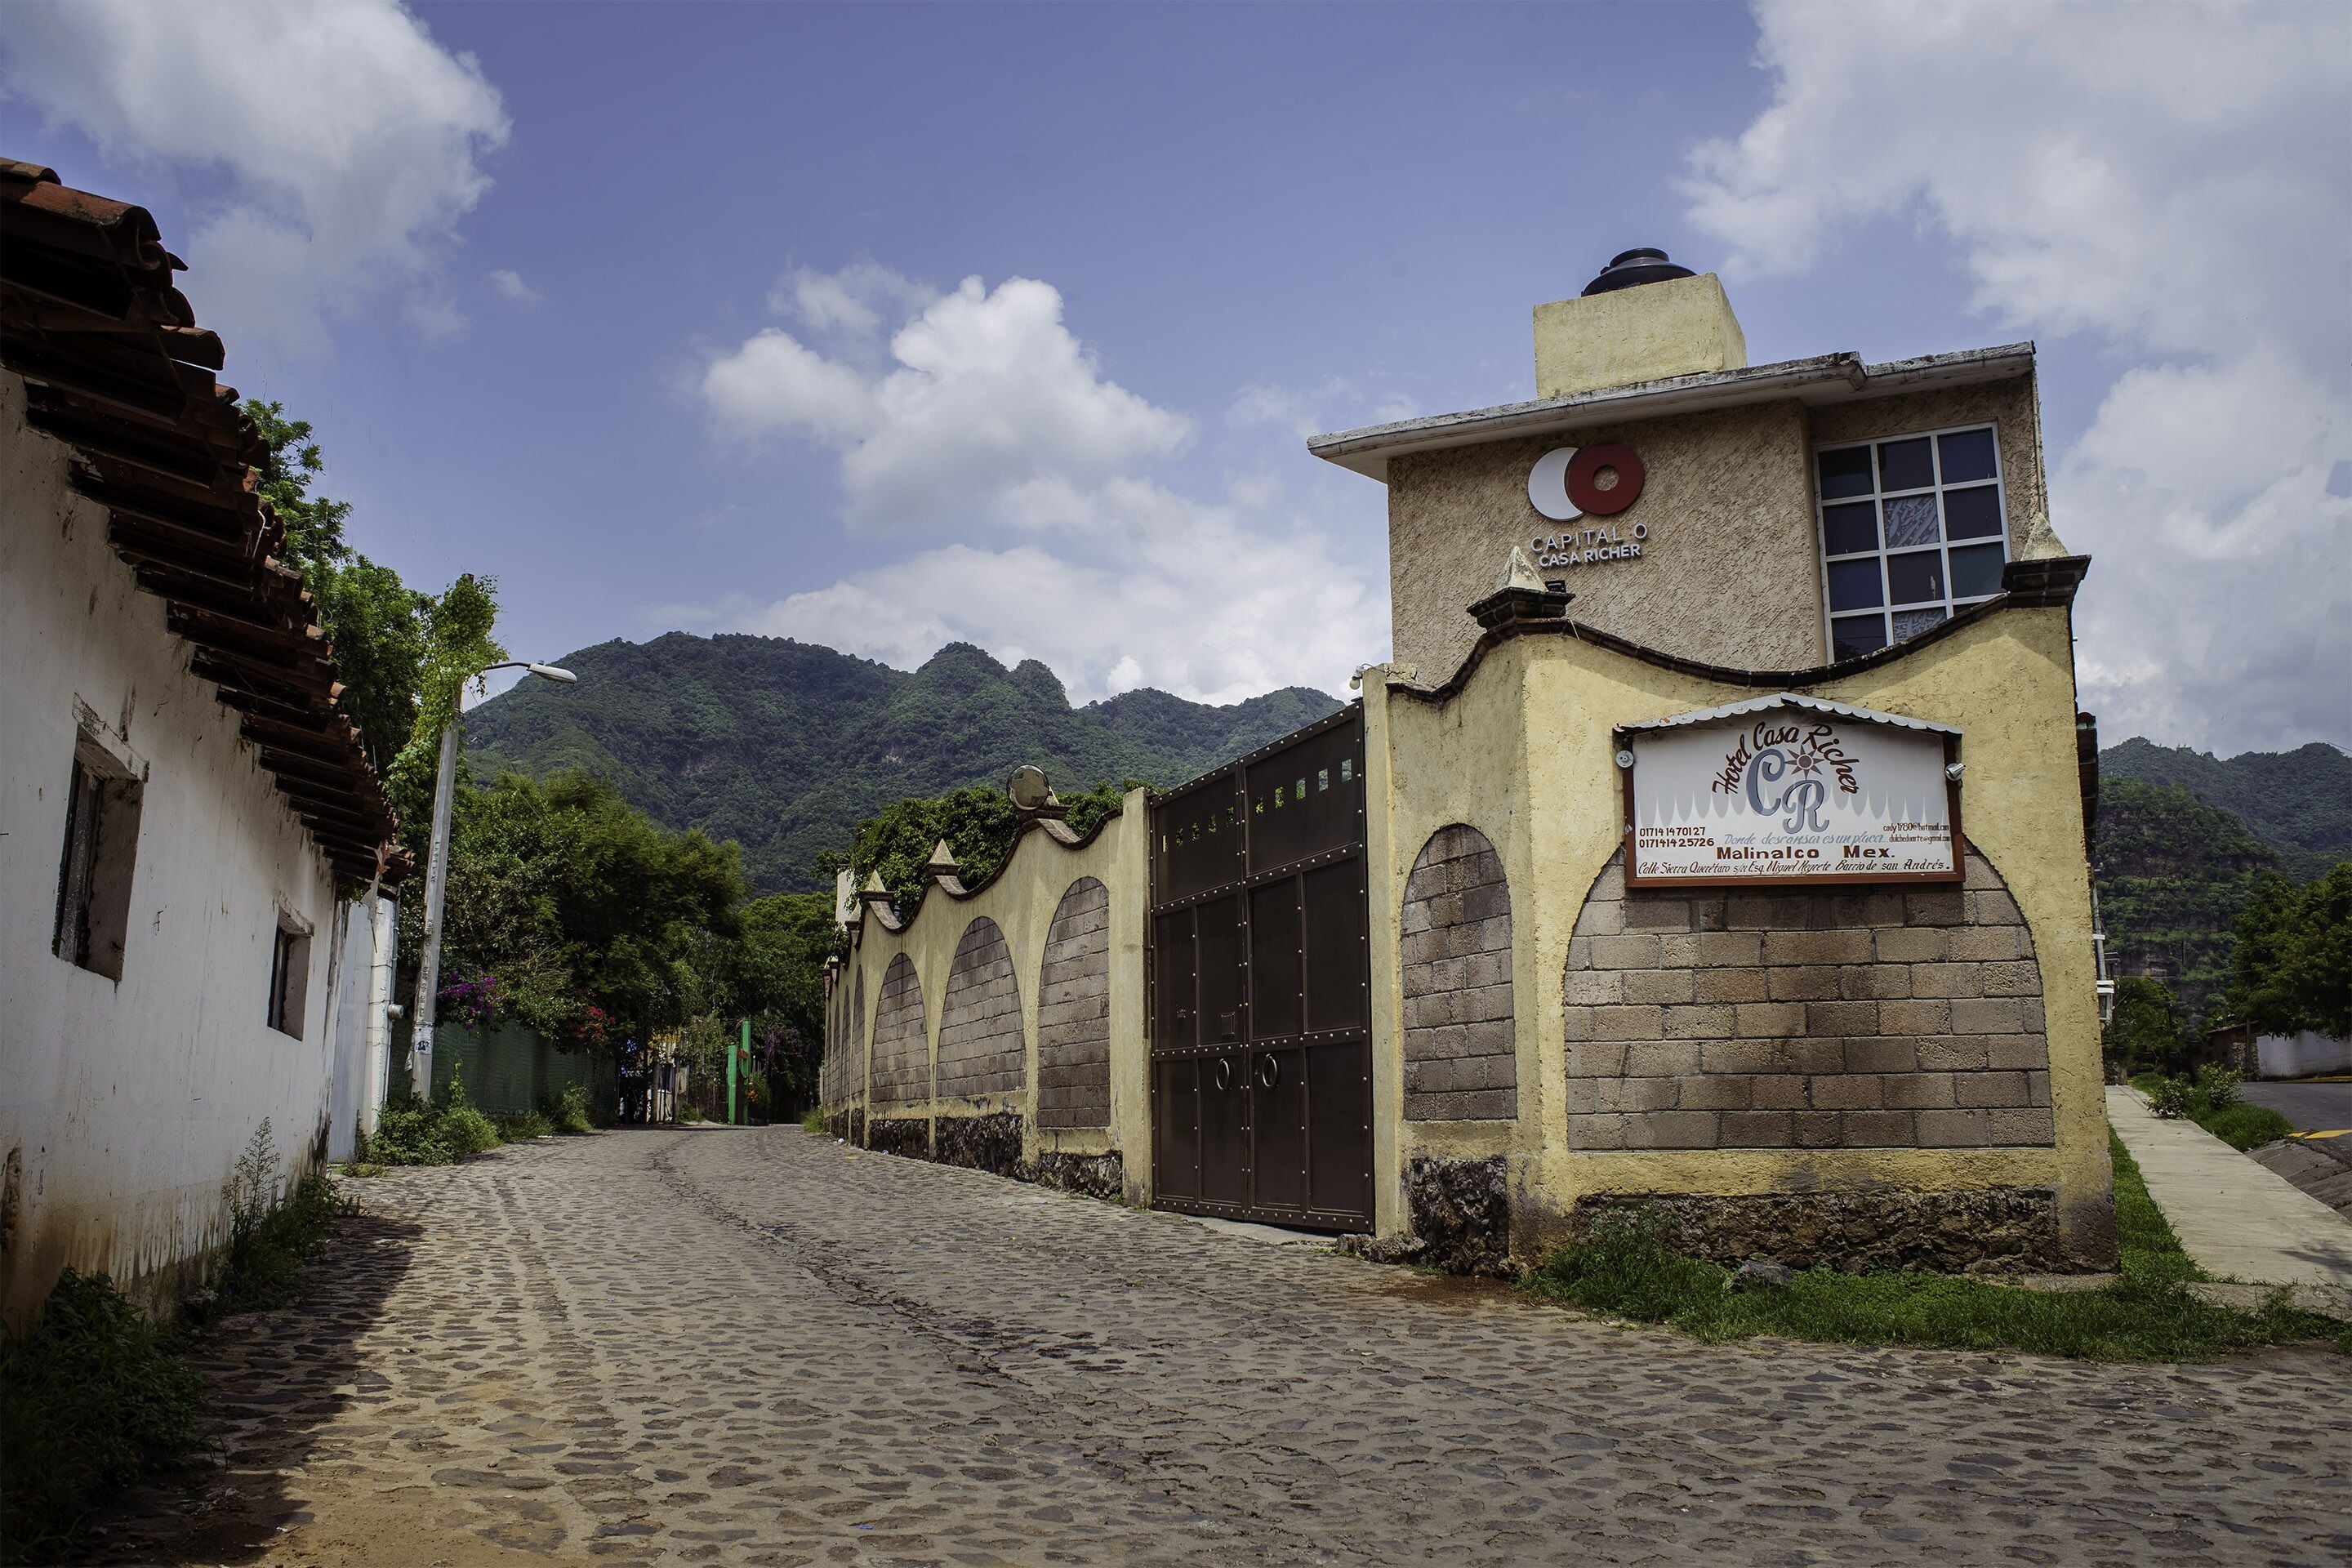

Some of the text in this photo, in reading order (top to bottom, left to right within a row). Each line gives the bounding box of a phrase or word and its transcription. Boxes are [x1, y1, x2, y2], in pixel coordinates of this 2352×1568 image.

[1531, 523, 1647, 552] CAPITAL O
[1539, 544, 1641, 568] CASA RICHER
[1712, 722, 1860, 794] Hotel Casa Richer
[1724, 831, 1884, 847] Donde descansar es un placer
[1717, 844, 1895, 860] Malinalco Mex.
[1638, 862, 1659, 874] Calle
[1660, 862, 1688, 874] Sierra
[1766, 860, 1799, 875] Miguel
[1835, 859, 1864, 871] Barrio
[1866, 859, 1878, 871] de
[1881, 862, 1899, 871] san
